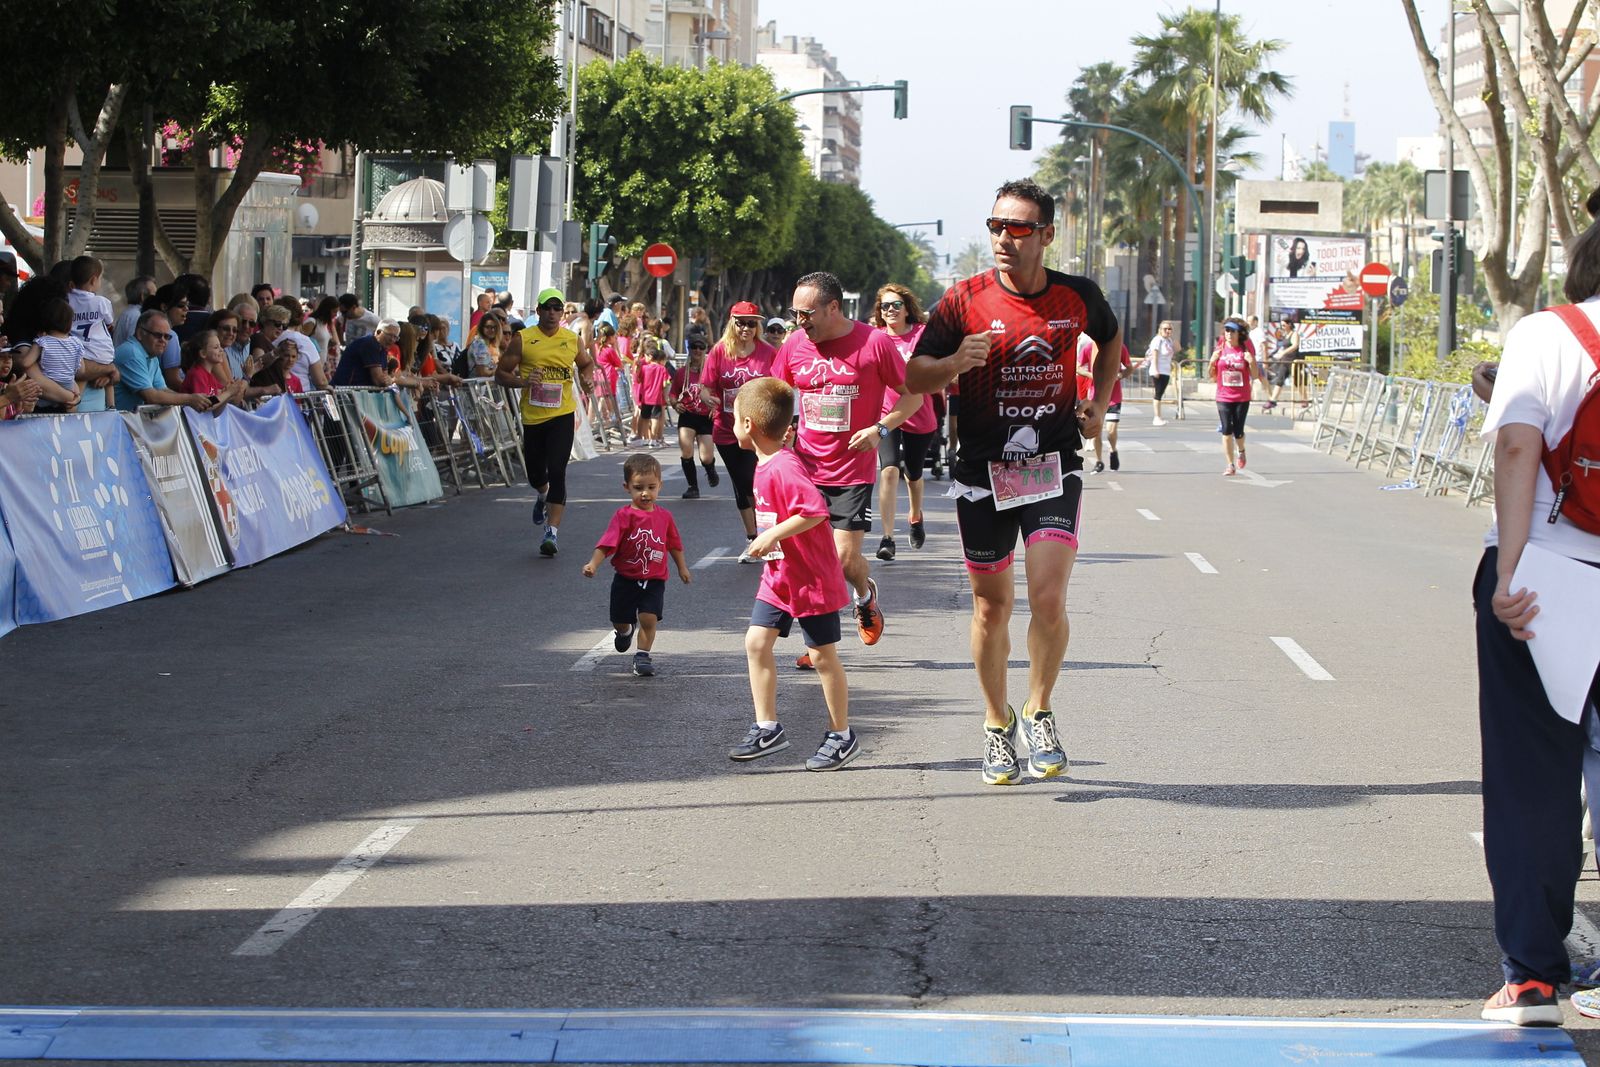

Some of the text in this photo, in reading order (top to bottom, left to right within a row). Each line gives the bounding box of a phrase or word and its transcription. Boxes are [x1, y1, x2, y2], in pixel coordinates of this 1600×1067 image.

[1340, 245, 1362, 257] TIENE
[76, 323, 92, 342] 7
[1300, 337, 1356, 350] ESISTENCIA
[1001, 372, 1063, 381] SALINAS CAR
